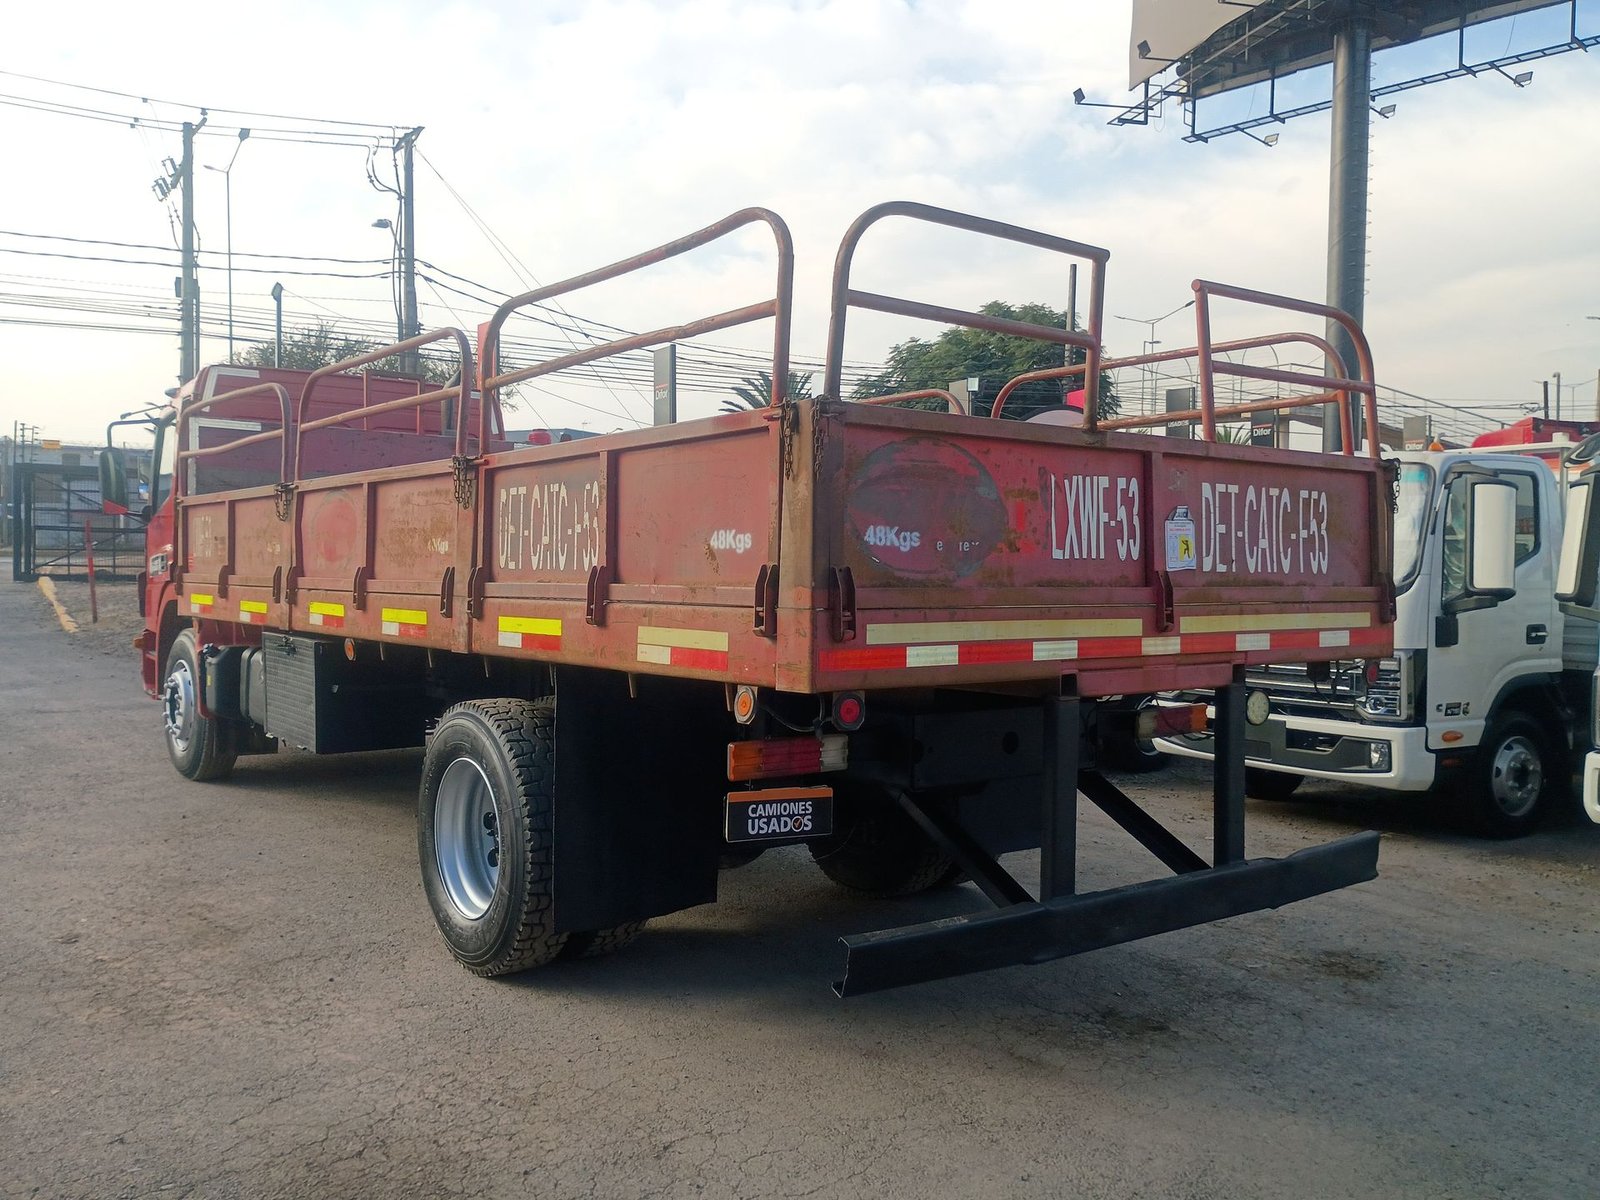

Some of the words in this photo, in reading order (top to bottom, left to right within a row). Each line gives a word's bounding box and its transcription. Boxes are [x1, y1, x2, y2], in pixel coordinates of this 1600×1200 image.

[1253, 428, 1272, 437] Difor
[1050, 473, 1140, 562] LXWF-53
[1201, 482, 1329, 575] DET-CATC-F53
[709, 529, 752, 554] 48Kgs
[863, 524, 921, 552] 48Kgs
[747, 801, 813, 817] CAMIONES
[747, 815, 813, 835] USADOS
